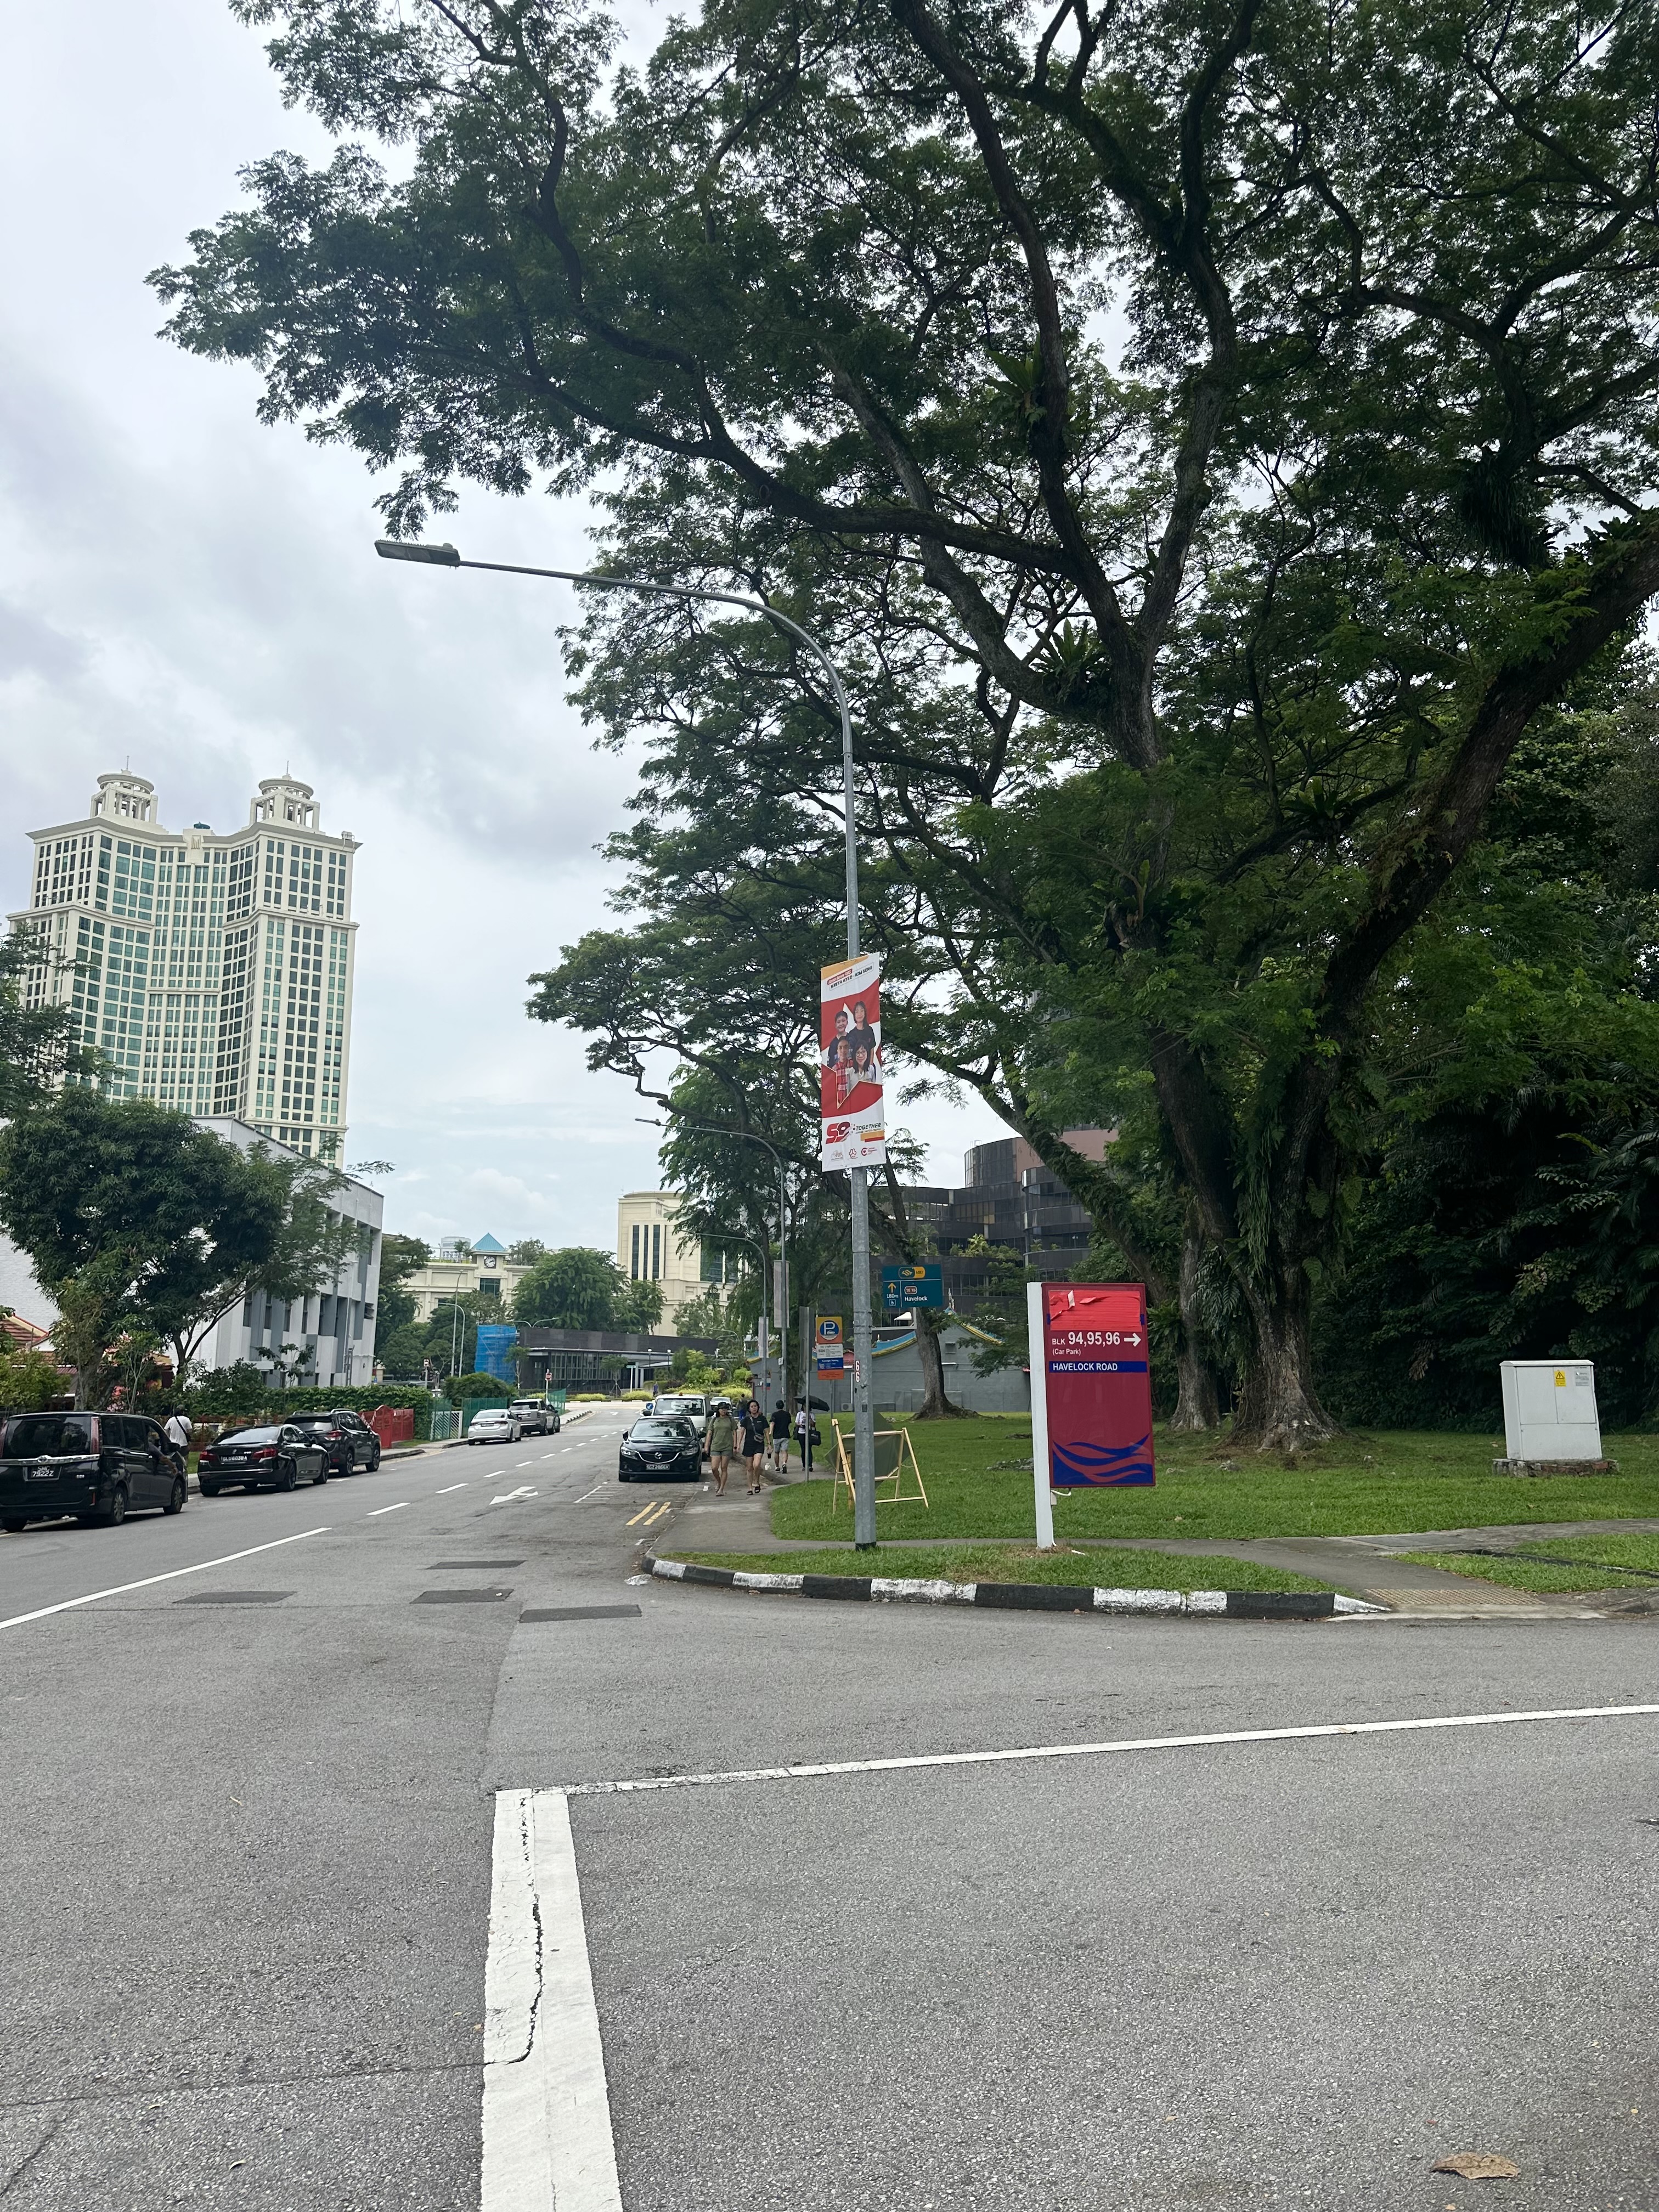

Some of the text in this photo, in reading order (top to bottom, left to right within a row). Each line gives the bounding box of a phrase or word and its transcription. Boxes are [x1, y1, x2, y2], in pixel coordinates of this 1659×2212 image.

[856, 1122, 881, 1131] TOGETHER
[1068, 1331, 1121, 1347] 94,95,96
[1052, 1348, 1081, 1356] (Car Park)
[1053, 1362, 1118, 1371] HAVELOCK ROAD
